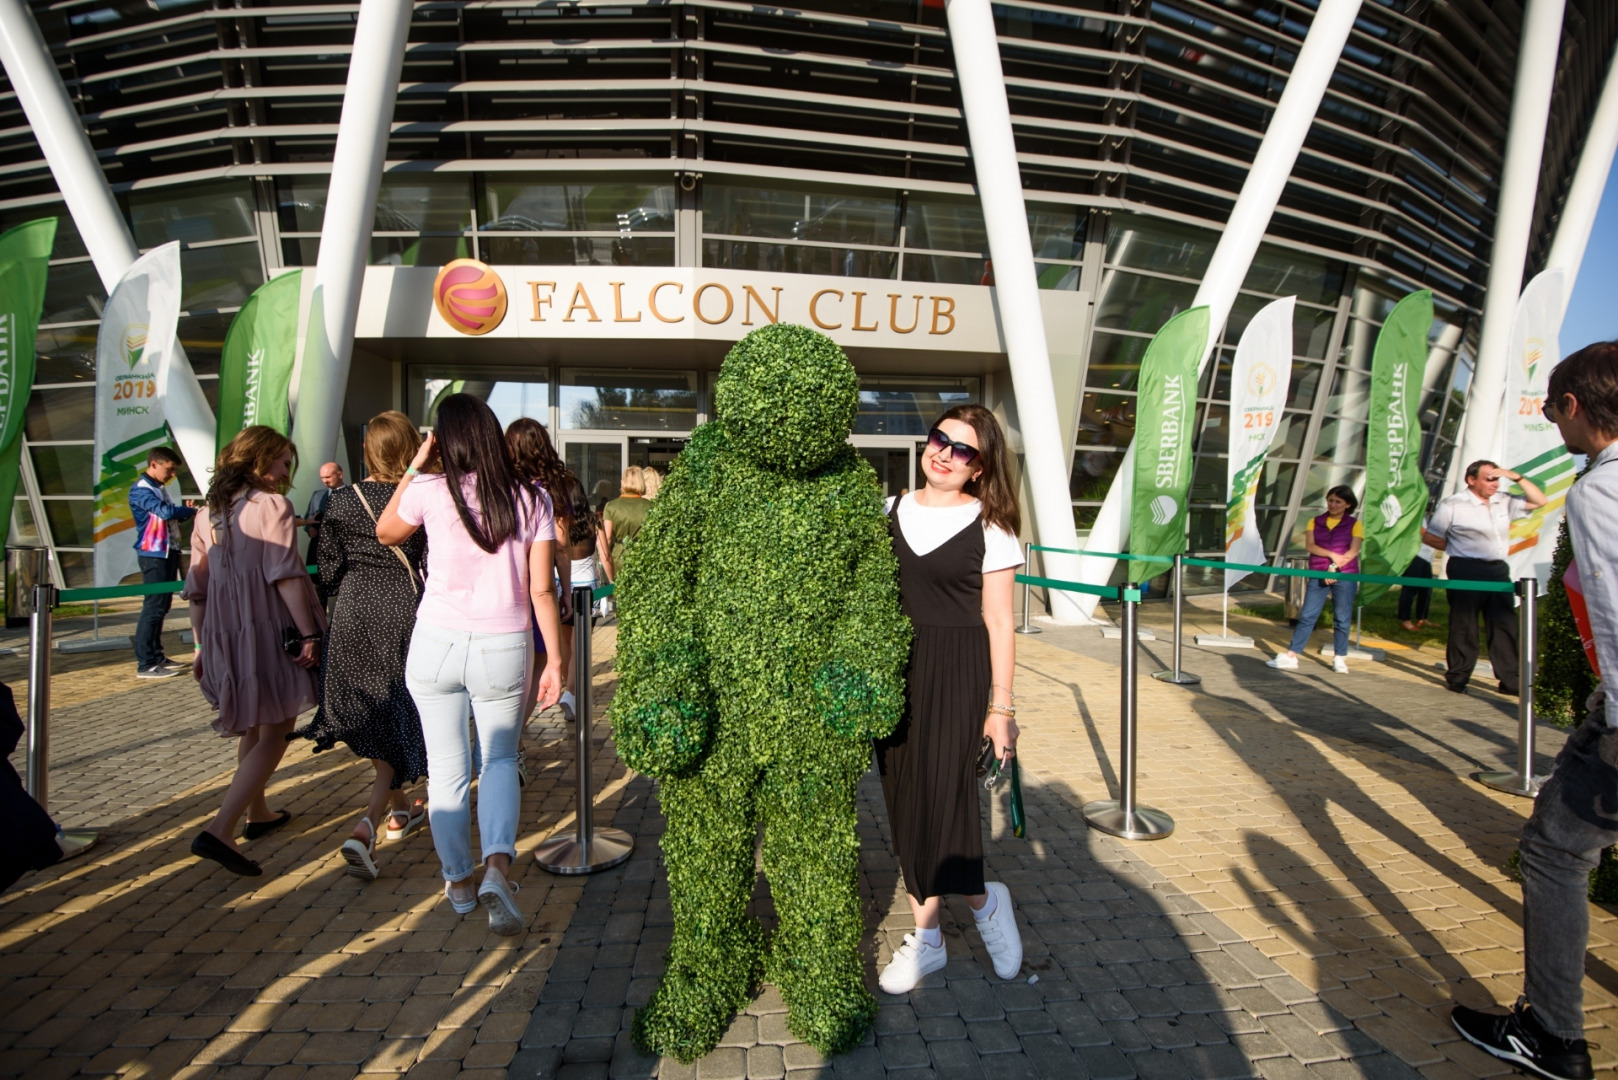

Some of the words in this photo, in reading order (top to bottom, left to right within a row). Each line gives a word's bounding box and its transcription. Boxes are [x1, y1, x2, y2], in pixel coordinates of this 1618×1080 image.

[526, 281, 784, 326] FALCON
[809, 289, 957, 335] CLUB
[113, 380, 156, 400] 2019
[242, 348, 260, 430] RBANK
[1518, 396, 1542, 415] 201
[117, 406, 149, 416] МИНСК
[1155, 374, 1181, 489] SBERBANK
